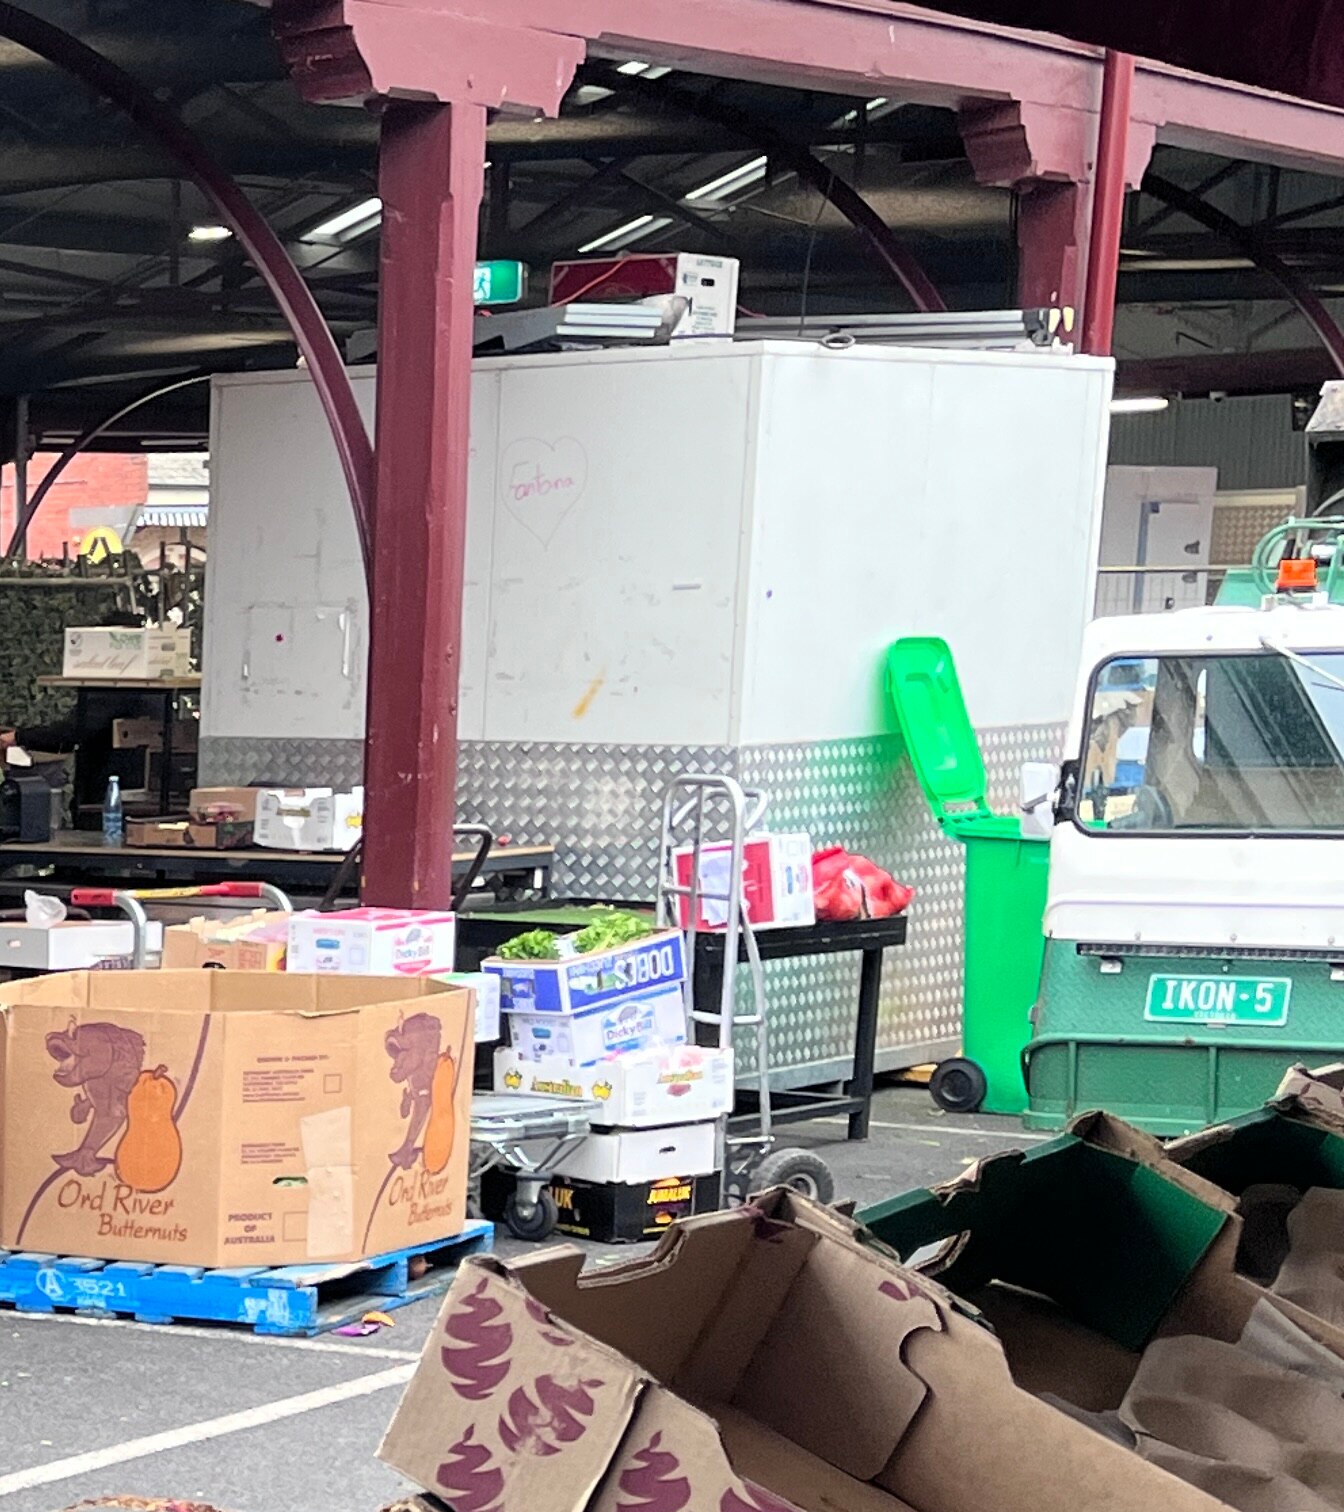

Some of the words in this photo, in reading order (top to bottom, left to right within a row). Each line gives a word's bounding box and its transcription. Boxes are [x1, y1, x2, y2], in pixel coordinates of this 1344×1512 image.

[58, 1178, 107, 1209] Ord
[113, 1183, 175, 1216] River
[228, 1211, 273, 1222] PRODUCT
[97, 1212, 189, 1242] Butternuts
[244, 1224, 257, 1234] OF
[223, 1235, 275, 1246] AUSTRALIA
